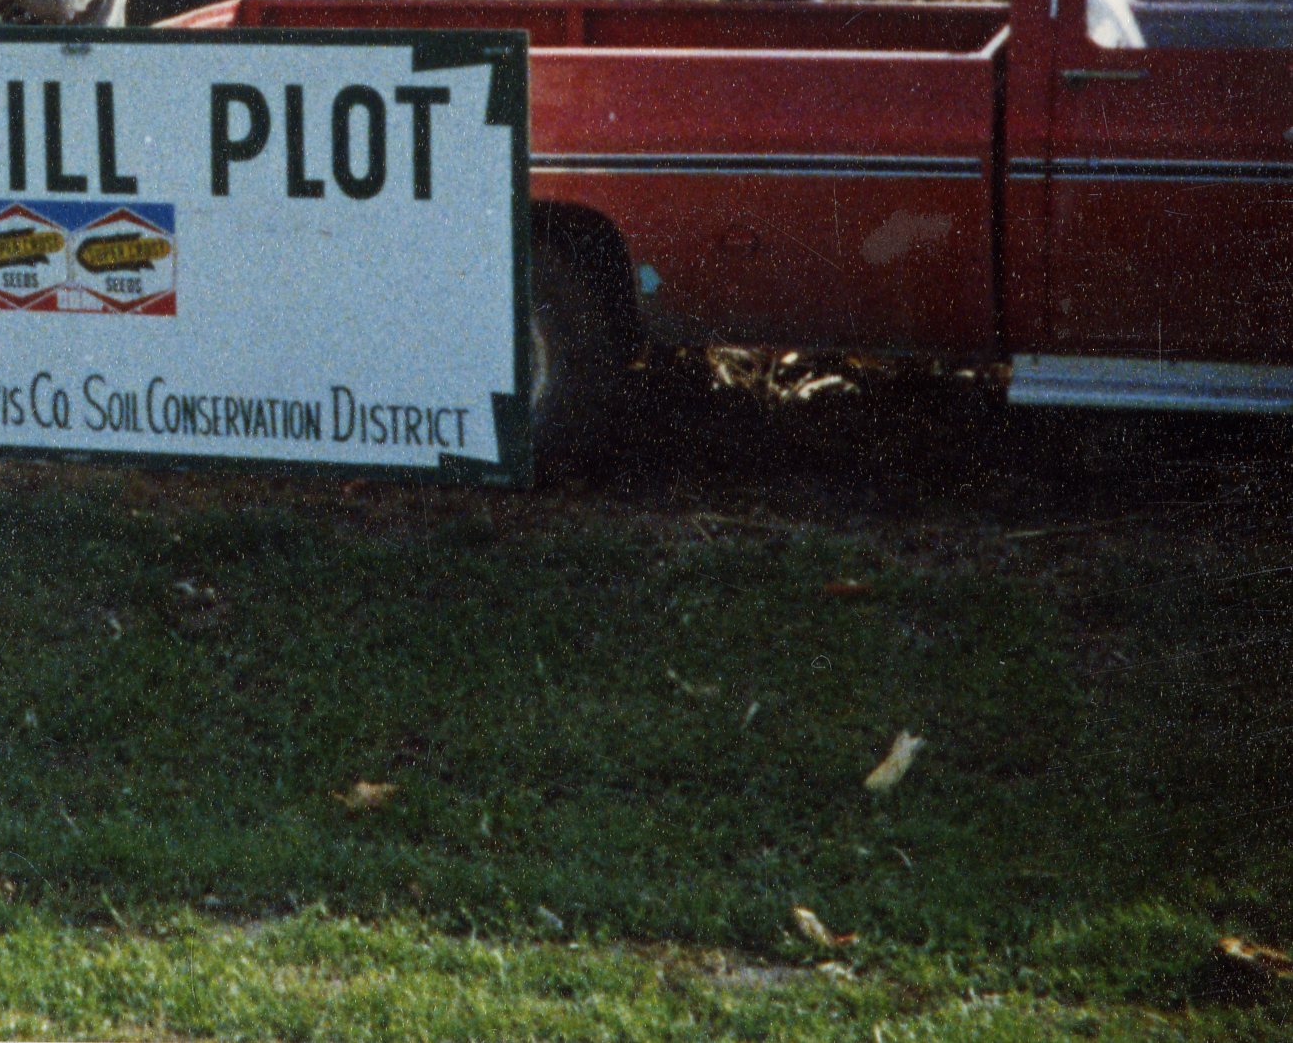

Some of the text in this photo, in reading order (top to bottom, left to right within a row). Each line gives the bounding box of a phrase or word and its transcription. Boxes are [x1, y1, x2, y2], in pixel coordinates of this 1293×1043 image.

[210, 82, 451, 200] PLOT
[2, 272, 40, 289] SEEDS
[105, 276, 143, 294] SEEDS
[82, 373, 143, 433] SOIL
[146, 376, 322, 442] CONSERVATION
[330, 384, 470, 448] DISTRICT
